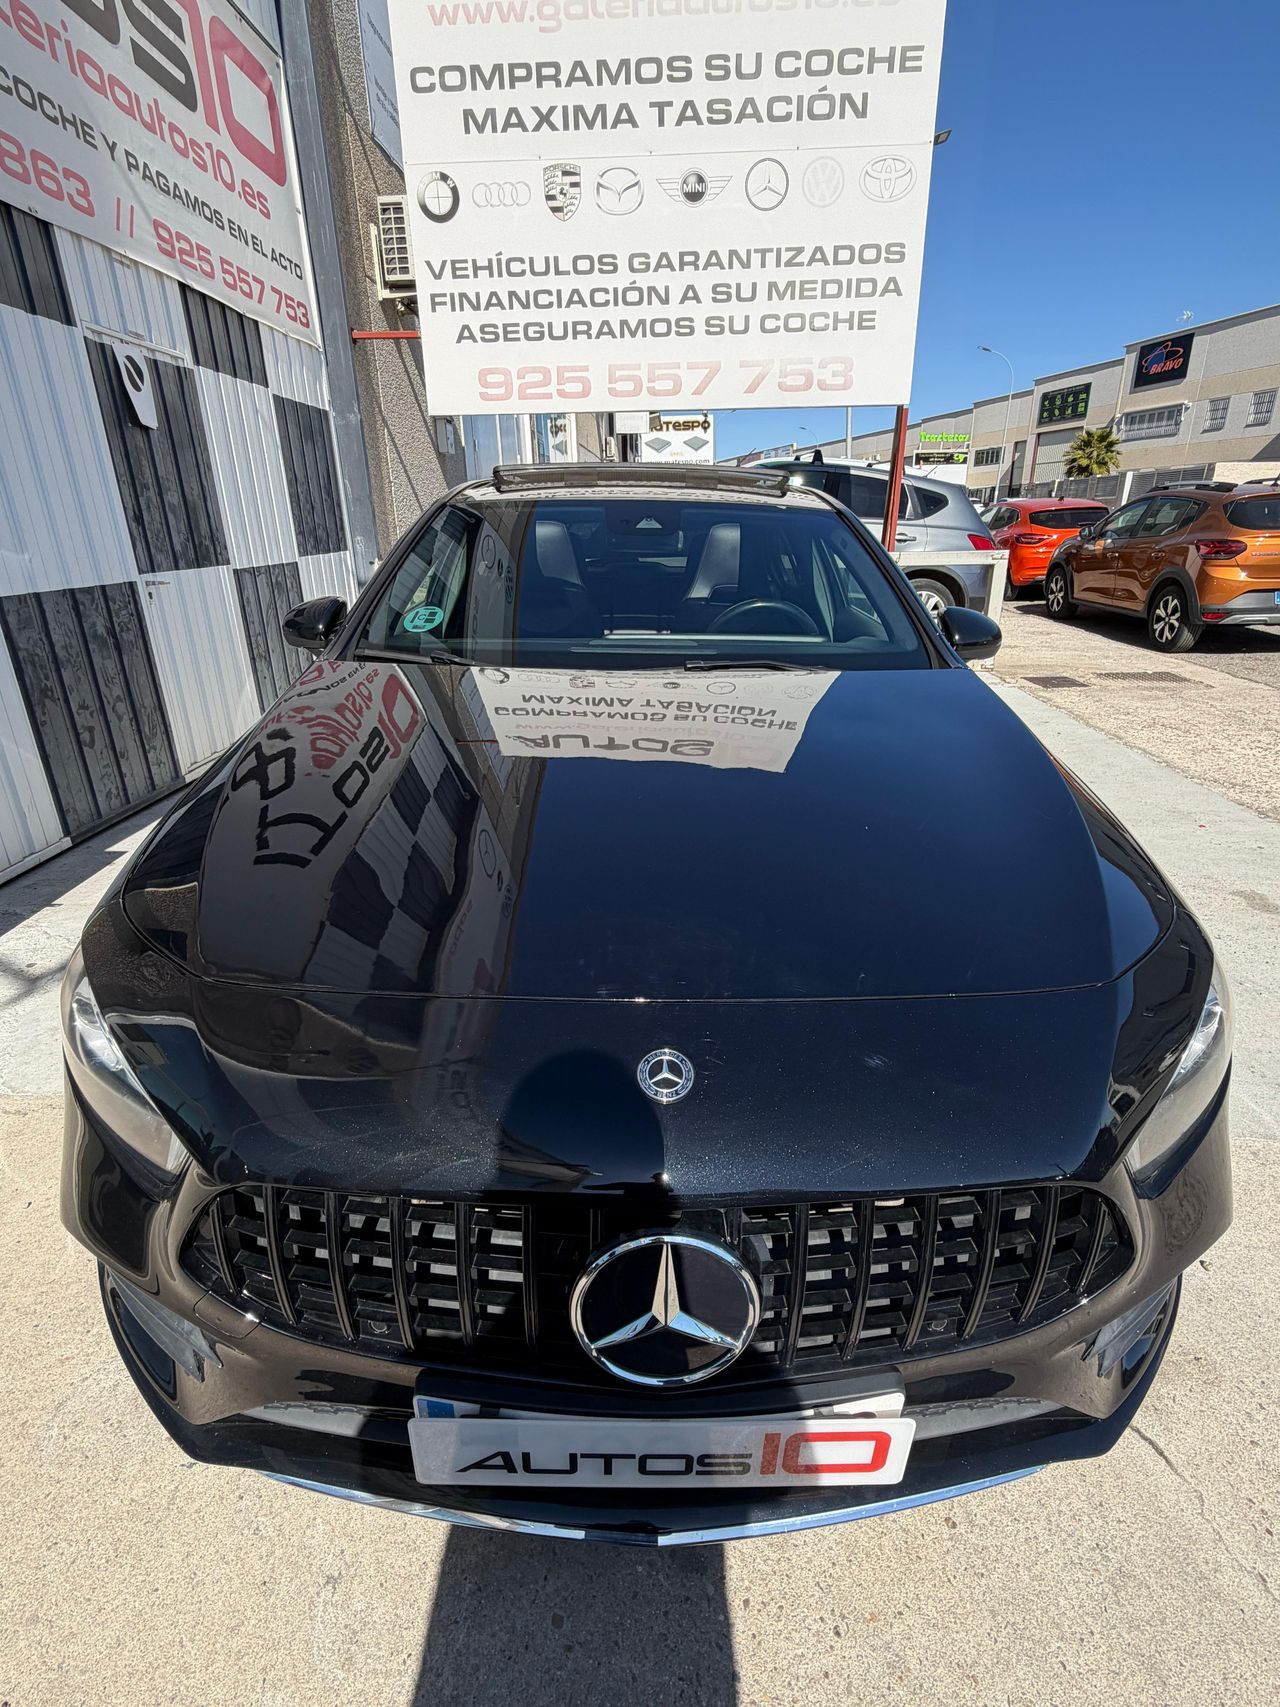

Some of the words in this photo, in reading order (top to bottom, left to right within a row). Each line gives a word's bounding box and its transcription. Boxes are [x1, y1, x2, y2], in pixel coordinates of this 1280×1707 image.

[409, 54, 693, 94] COMPRAMOS
[704, 51, 763, 83] SU
[773, 44, 925, 77] COCHE
[0, 0, 271, 221] eriaautos10.es
[462, 102, 639, 135] MAXIMA
[648, 85, 869, 128] TASACIÓN
[100, 131, 118, 162] Y
[124, 148, 226, 231] PAGAMOS
[228, 220, 250, 249] EN
[250, 234, 268, 258] EL
[270, 252, 304, 281] ACTO
[682, 182, 707, 194] MINI
[153, 218, 216, 281] 925
[219, 256, 266, 305] 557
[270, 286, 311, 329] 753
[424, 251, 620, 281] VEHÍCULOS
[626, 242, 907, 274] GARANTIZADOS
[428, 280, 671, 314] FINANCIACIÓN
[679, 284, 704, 305] A
[711, 282, 758, 304] SU
[766, 276, 904, 301] MEDIDA
[454, 316, 696, 345] ASEGURAMOS
[704, 313, 752, 337] SU
[759, 309, 878, 335] COCHE
[476, 364, 592, 402] 925
[606, 360, 722, 399] 557
[738, 356, 855, 395] 753
[1149, 358, 1184, 375] BRAVO
